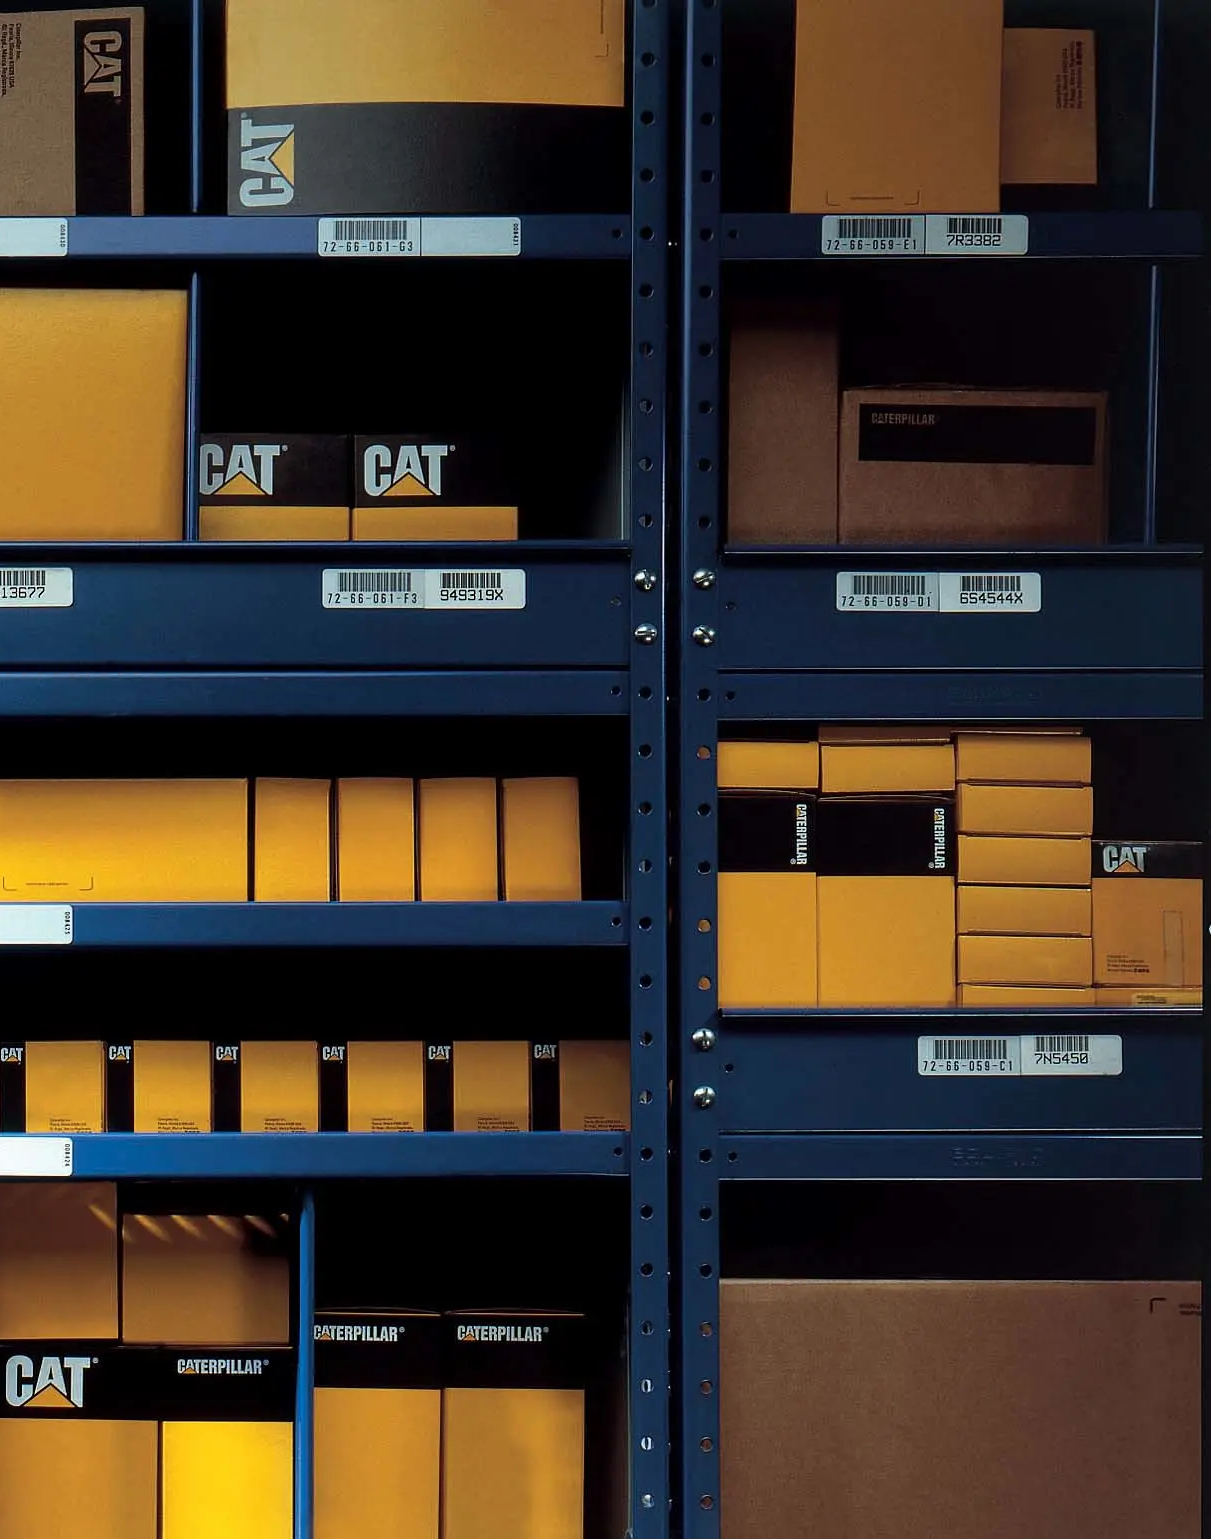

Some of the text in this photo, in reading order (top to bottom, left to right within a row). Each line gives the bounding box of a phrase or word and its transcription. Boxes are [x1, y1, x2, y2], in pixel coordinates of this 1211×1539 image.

[82, 31, 123, 98] CAT
[239, 118, 295, 209] CAT
[323, 240, 413, 252] 72-66-061-G3
[827, 239, 916, 250] 72-66-059-E1
[948, 233, 1001, 246] 7R3382
[871, 412, 936, 426] CATERPILLAR
[199, 443, 280, 496] CAT
[363, 444, 448, 497] CAT
[327, 592, 417, 603] 72-66-061-F3
[441, 588, 503, 600] 949319X
[841, 595, 931, 607] 72-66-059-D1
[960, 592, 1023, 604] 6S4544X
[797, 803, 808, 864] CATERPILLAR
[934, 808, 945, 868] CATERPILLAR
[1103, 846, 1147, 873] CAT
[0, 1047, 23, 1063] CAT
[108, 1046, 131, 1062] CAT
[215, 1046, 238, 1062] CAT
[322, 1046, 345, 1062] CAT
[428, 1045, 451, 1061] CAT
[534, 1044, 557, 1060] CAT
[1035, 1053, 1088, 1064] 7N5450
[923, 1059, 1012, 1071] 72-66-059-C1
[314, 1325, 397, 1341] CATERPILLAR
[456, 1326, 541, 1342] CATERPILLAR
[177, 1359, 262, 1375] CATERPILLAR
[5, 1355, 90, 1408] CAT
